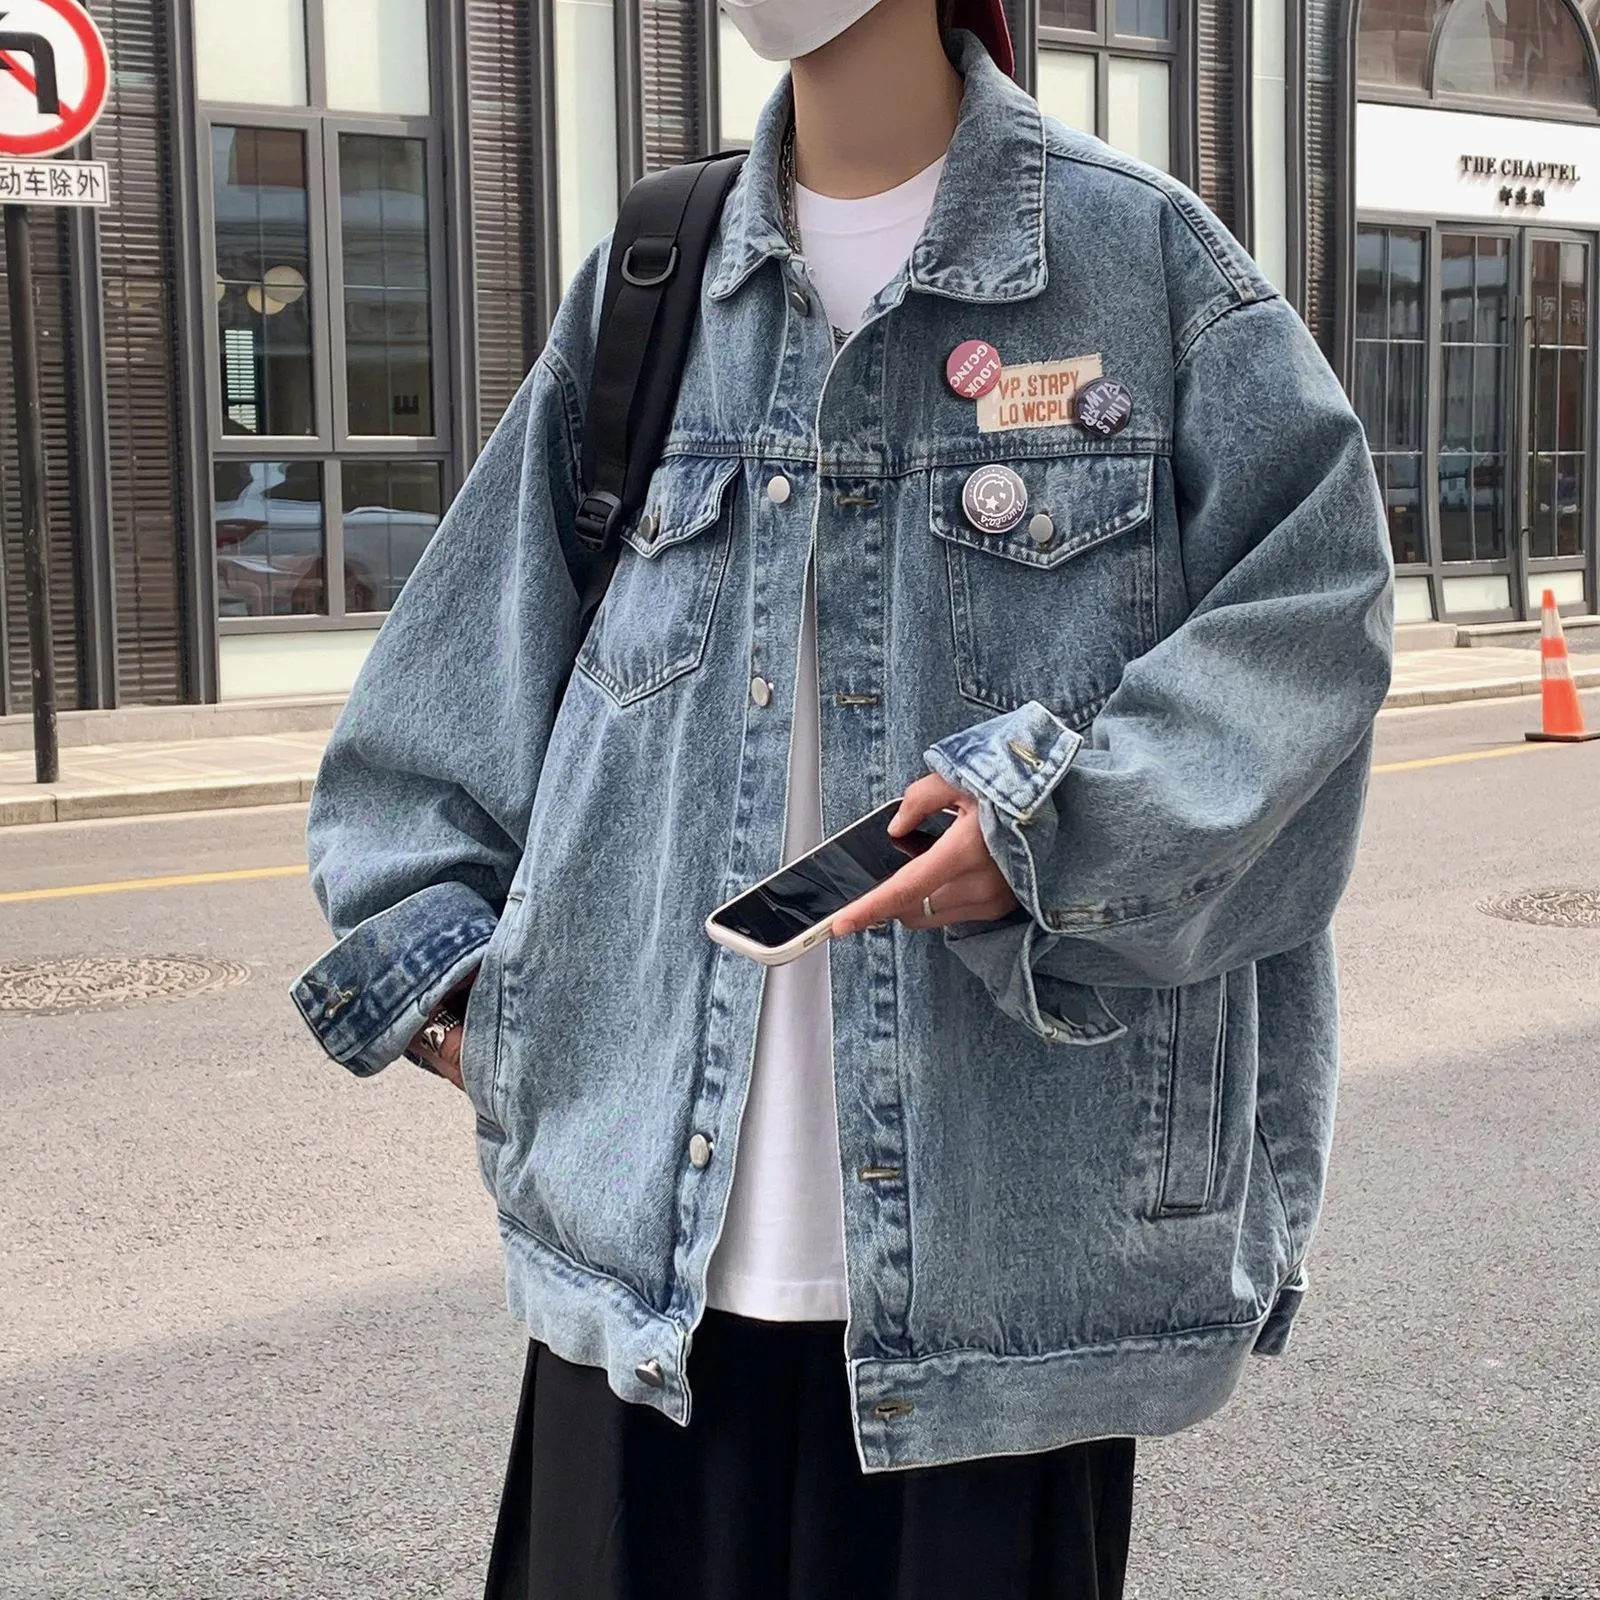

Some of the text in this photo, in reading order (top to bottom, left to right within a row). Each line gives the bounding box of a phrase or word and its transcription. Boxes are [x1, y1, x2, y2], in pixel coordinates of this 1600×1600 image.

[1460, 154, 1497, 175] THE
[0, 166, 100, 198] 动车除外
